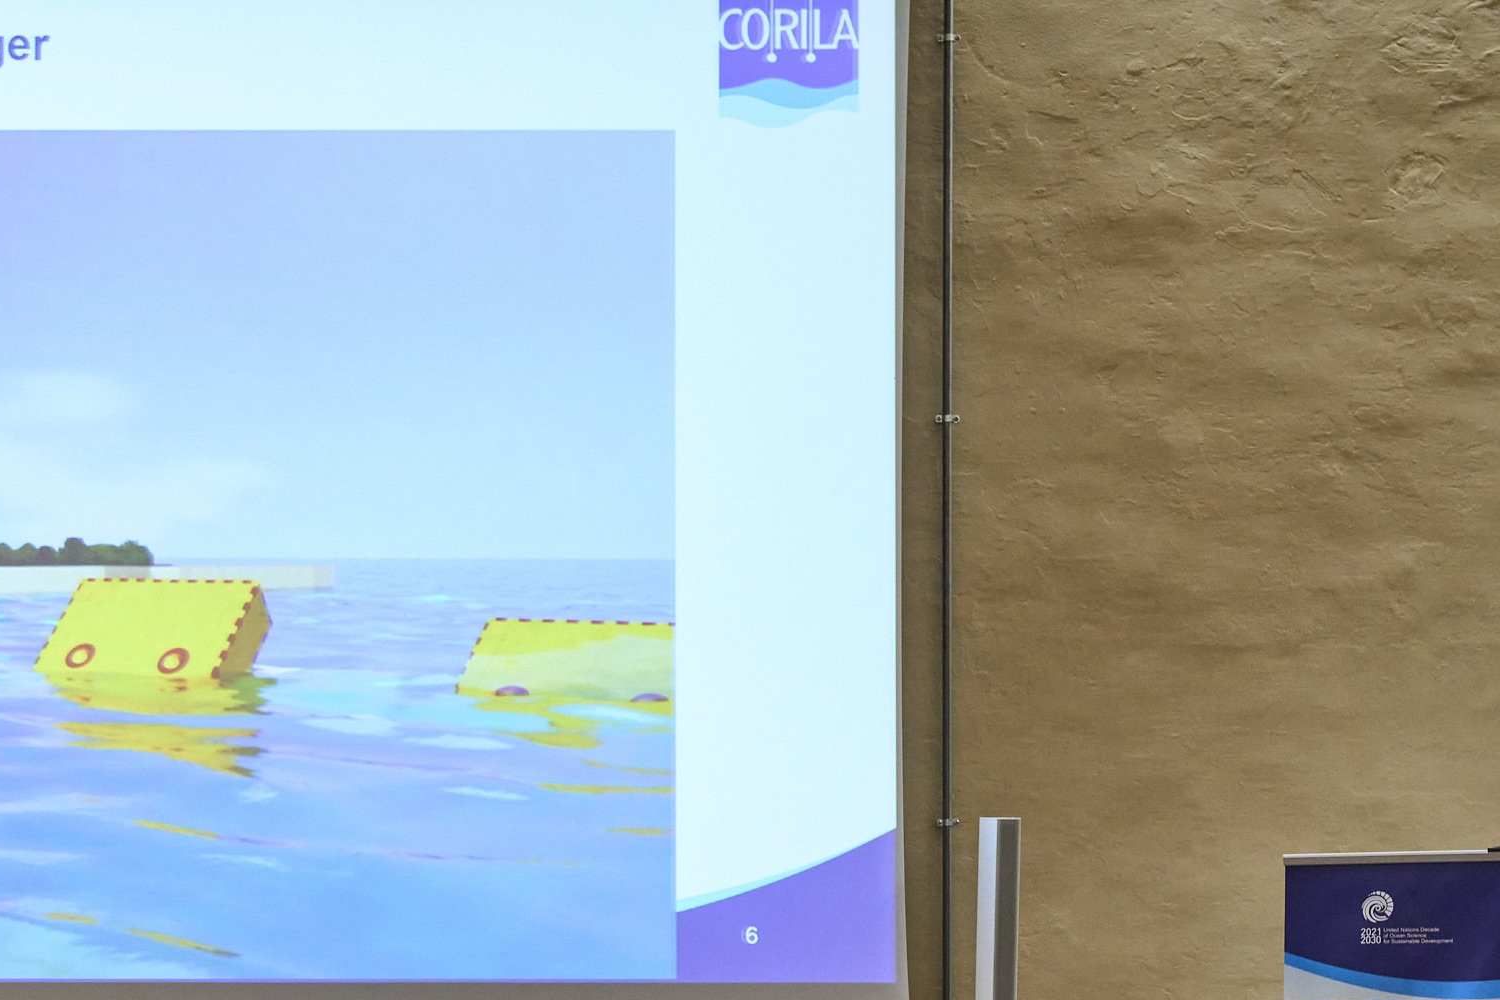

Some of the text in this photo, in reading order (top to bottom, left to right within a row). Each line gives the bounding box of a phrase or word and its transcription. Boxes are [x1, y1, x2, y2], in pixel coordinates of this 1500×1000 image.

[719, 8, 859, 50] CORILA
[745, 926, 759, 945] 6
[1360, 927, 1381, 936] 2021
[1360, 936, 1382, 944] 2030
